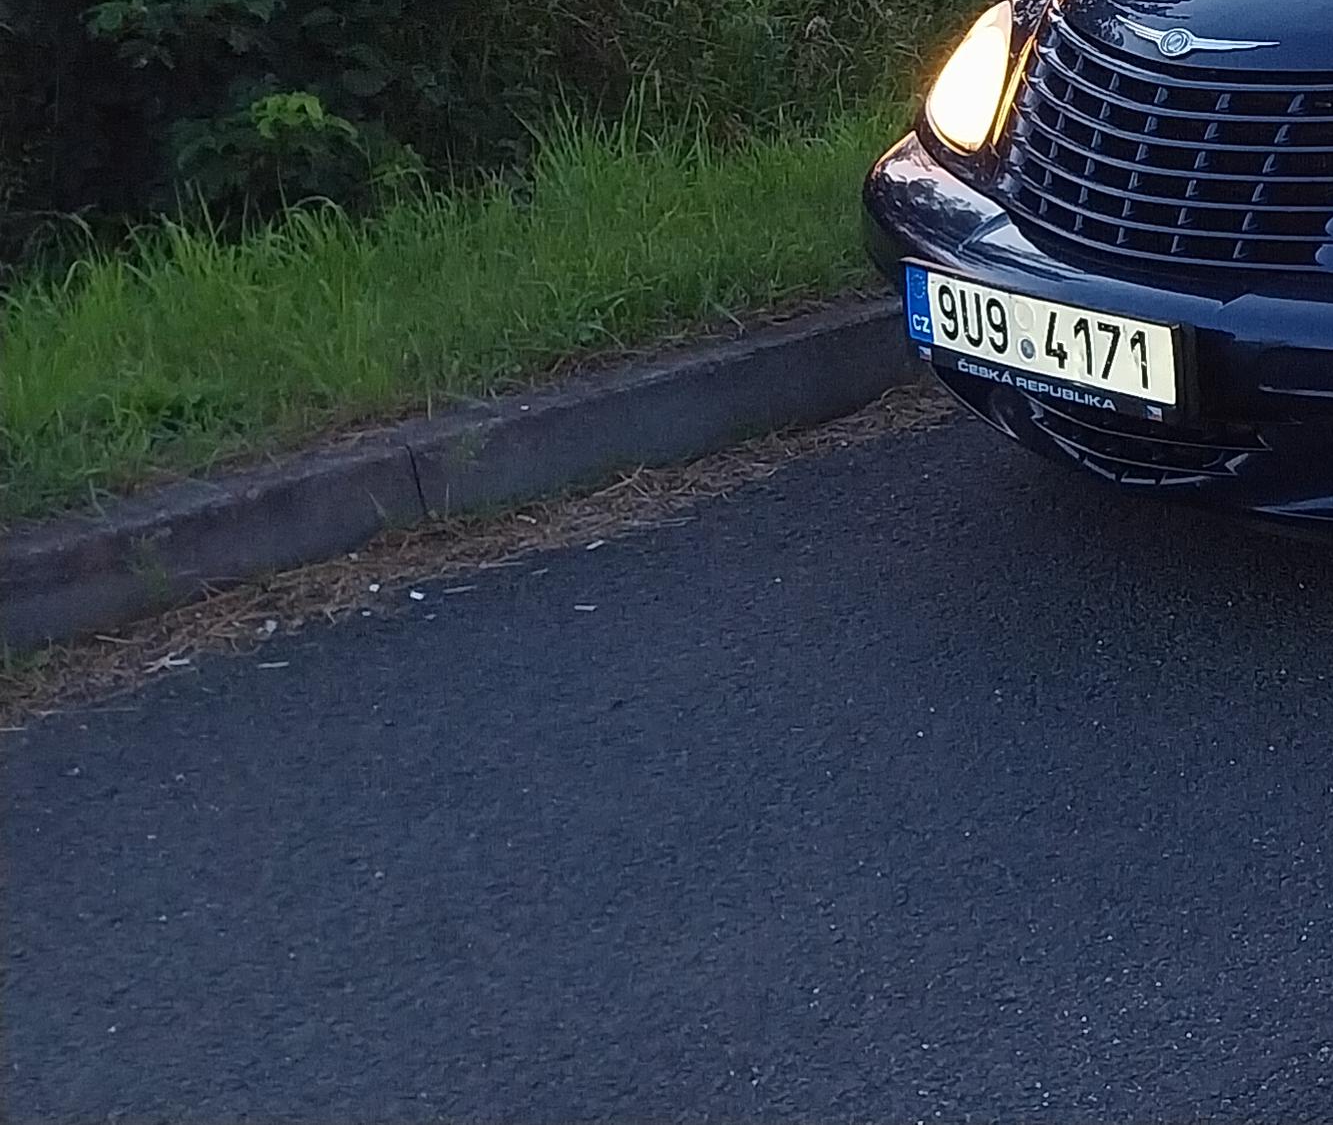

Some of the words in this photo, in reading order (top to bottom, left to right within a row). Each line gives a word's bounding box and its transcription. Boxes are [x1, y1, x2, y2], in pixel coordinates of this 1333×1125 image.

[912, 314, 931, 334] CZ
[938, 284, 1009, 355] 9U9
[1045, 311, 1149, 390] 4171
[957, 360, 1014, 386] ČESKÁ
[1015, 377, 1117, 412] REPUBLIKA
